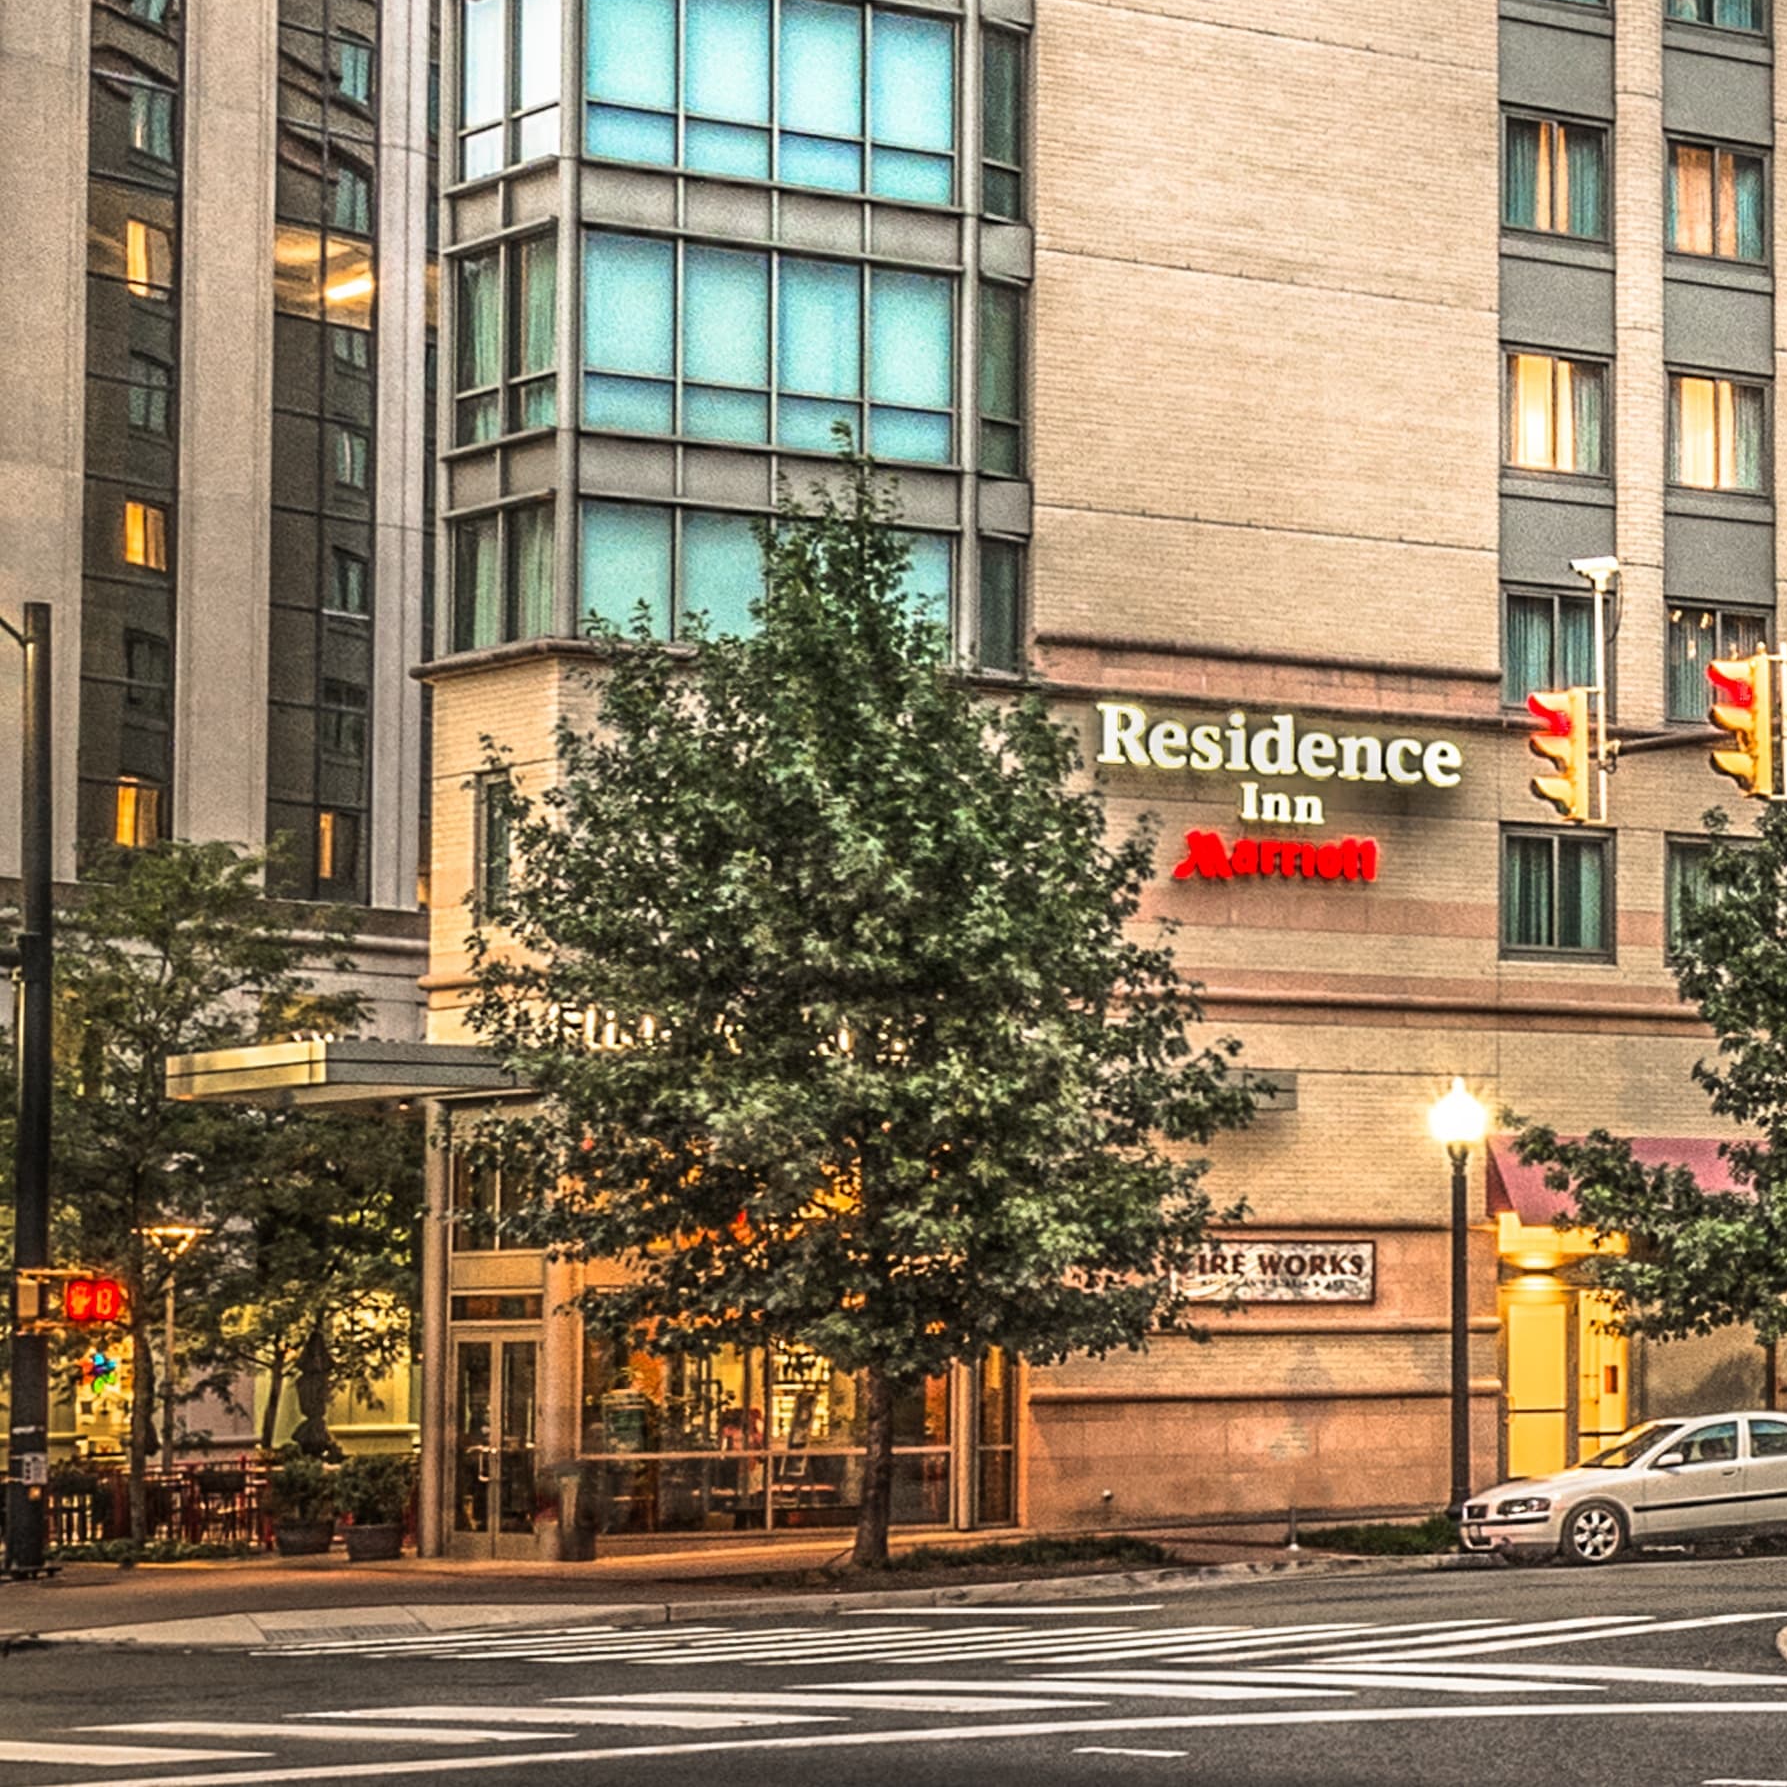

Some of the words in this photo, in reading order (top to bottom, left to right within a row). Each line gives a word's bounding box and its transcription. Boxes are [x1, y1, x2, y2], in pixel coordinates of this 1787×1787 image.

[1096, 701, 1463, 787] Residence
[1240, 781, 1325, 825] Inn
[1174, 829, 1379, 882] Marriott
[1184, 1254, 1246, 1276] IRE
[1257, 1254, 1364, 1276] WORKS
